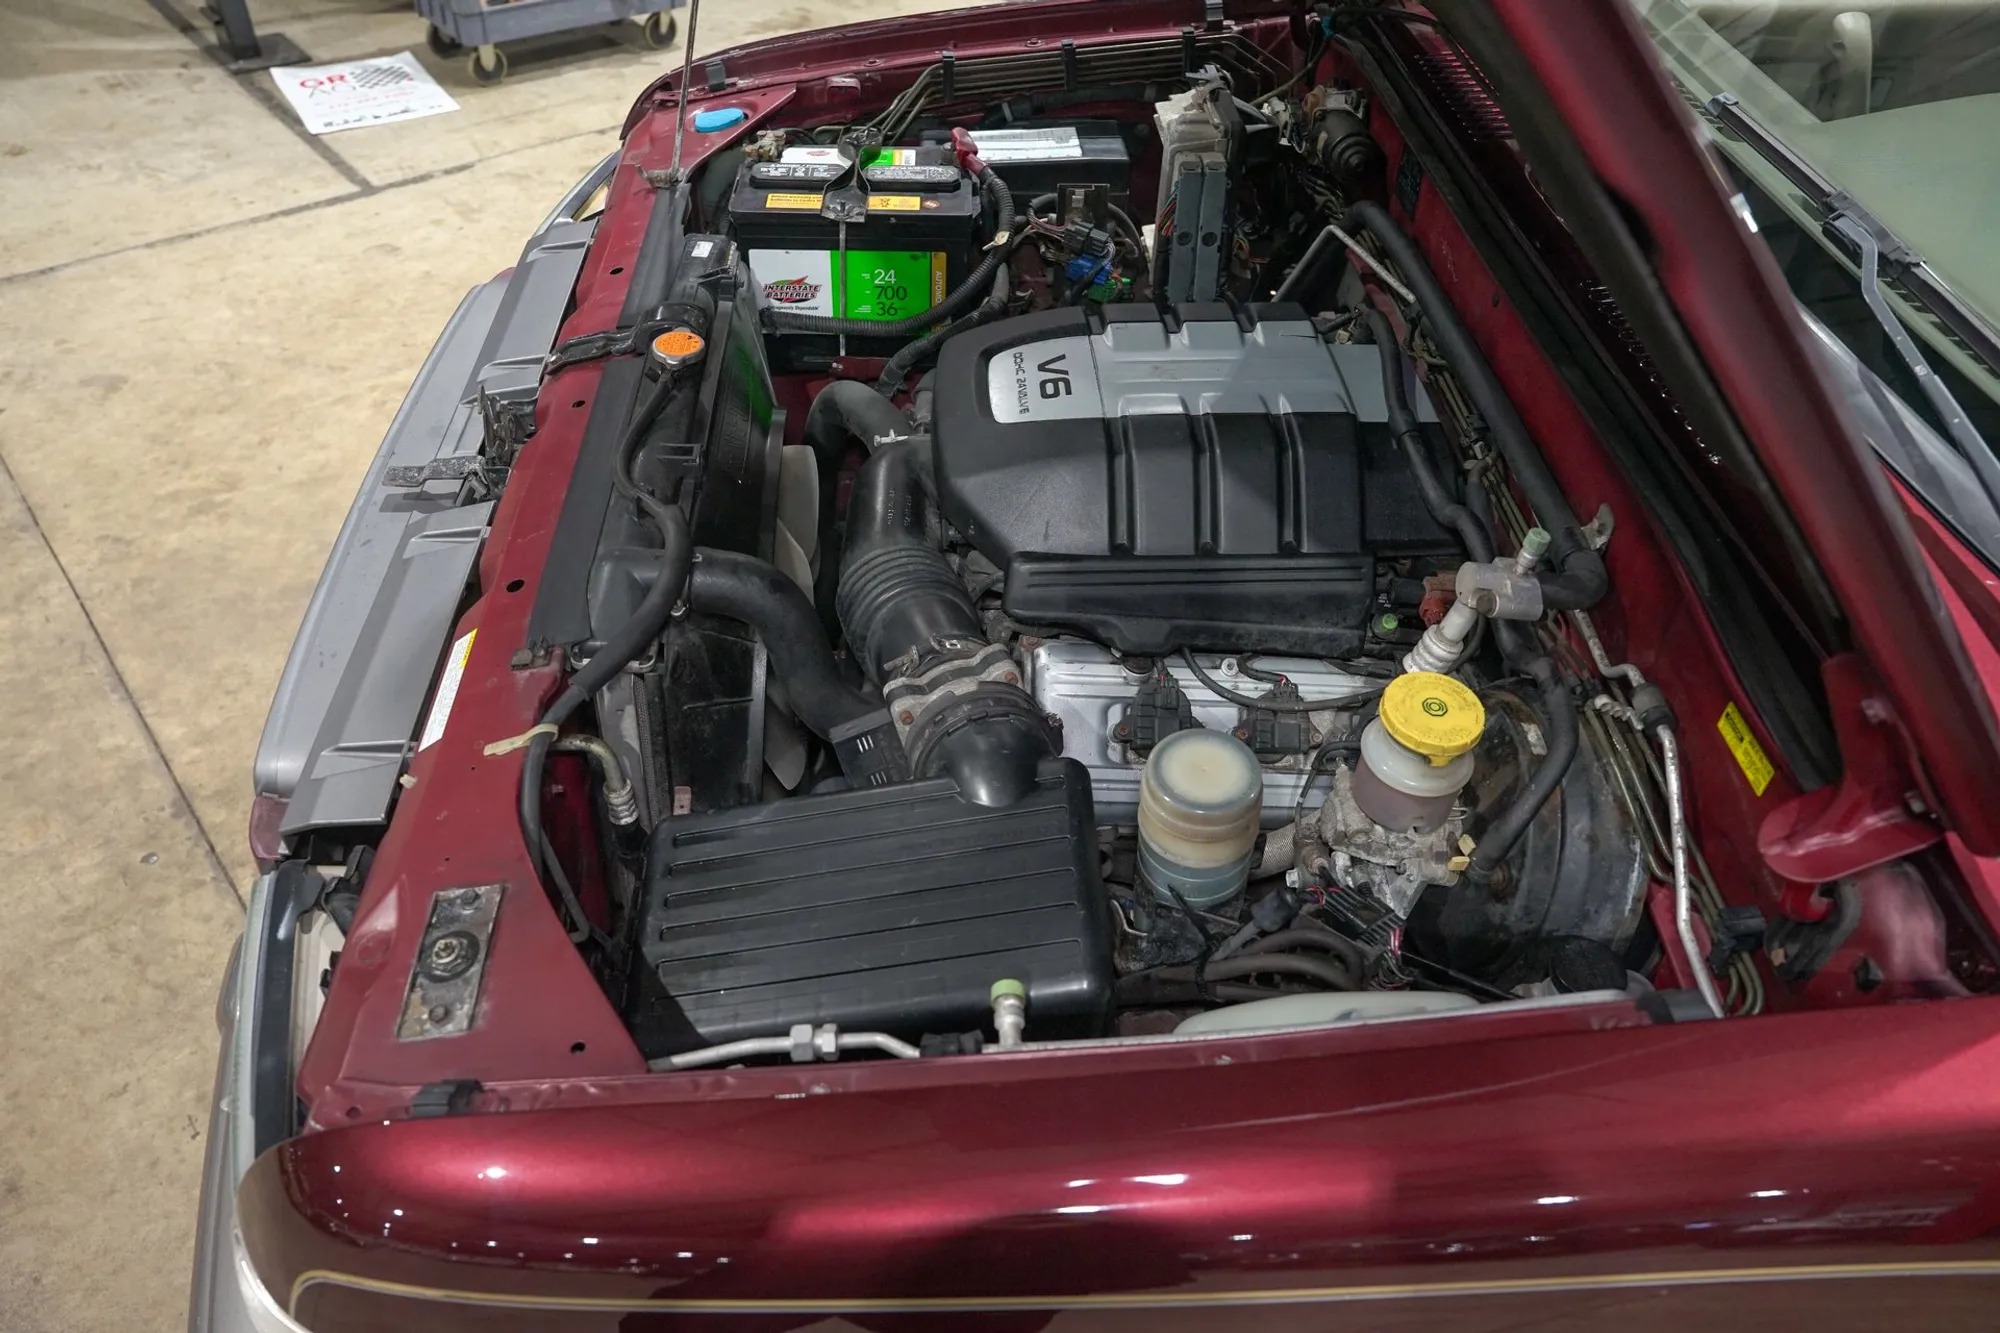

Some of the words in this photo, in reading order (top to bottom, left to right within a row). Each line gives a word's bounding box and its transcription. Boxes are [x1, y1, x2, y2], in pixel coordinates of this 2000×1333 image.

[874, 268, 897, 284] 24
[763, 284, 821, 292] INTERSTATE
[874, 285, 908, 301] 700
[935, 270, 943, 304] AUTOMO
[876, 301, 898, 317] 36
[1037, 353, 1072, 399] V6
